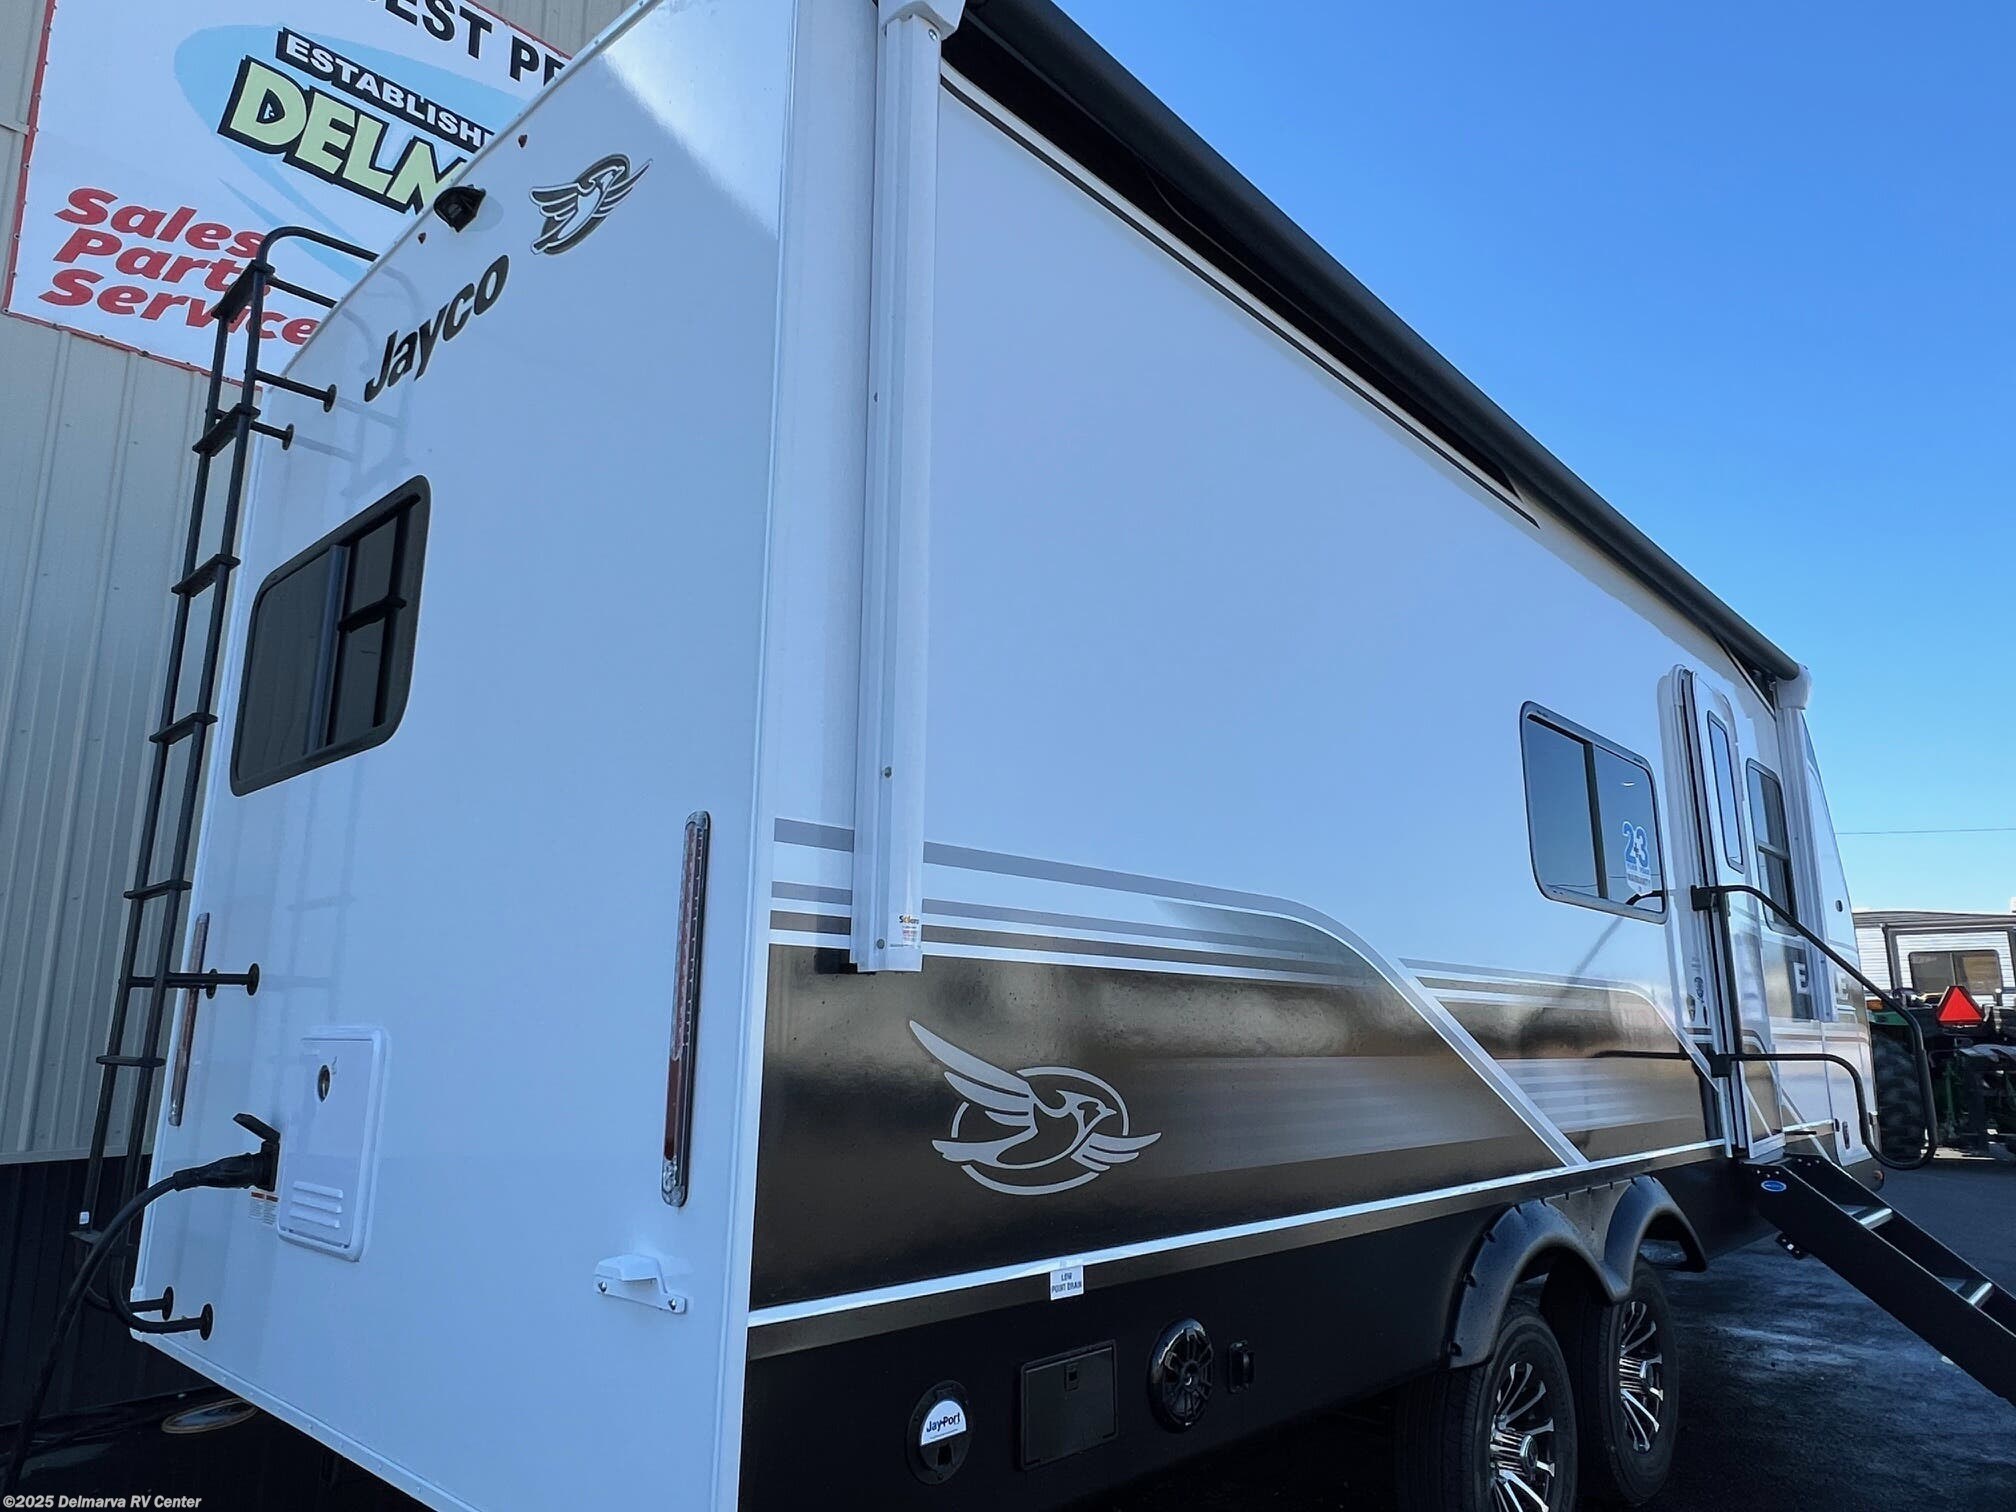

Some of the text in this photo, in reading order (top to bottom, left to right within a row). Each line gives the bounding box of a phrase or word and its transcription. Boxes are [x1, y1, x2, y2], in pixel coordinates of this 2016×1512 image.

[283, 31, 494, 148] ESTABLISH
[54, 187, 267, 258] Sales
[53, 228, 271, 296] Part
[38, 269, 321, 345] Service
[364, 254, 509, 402] Jayco
